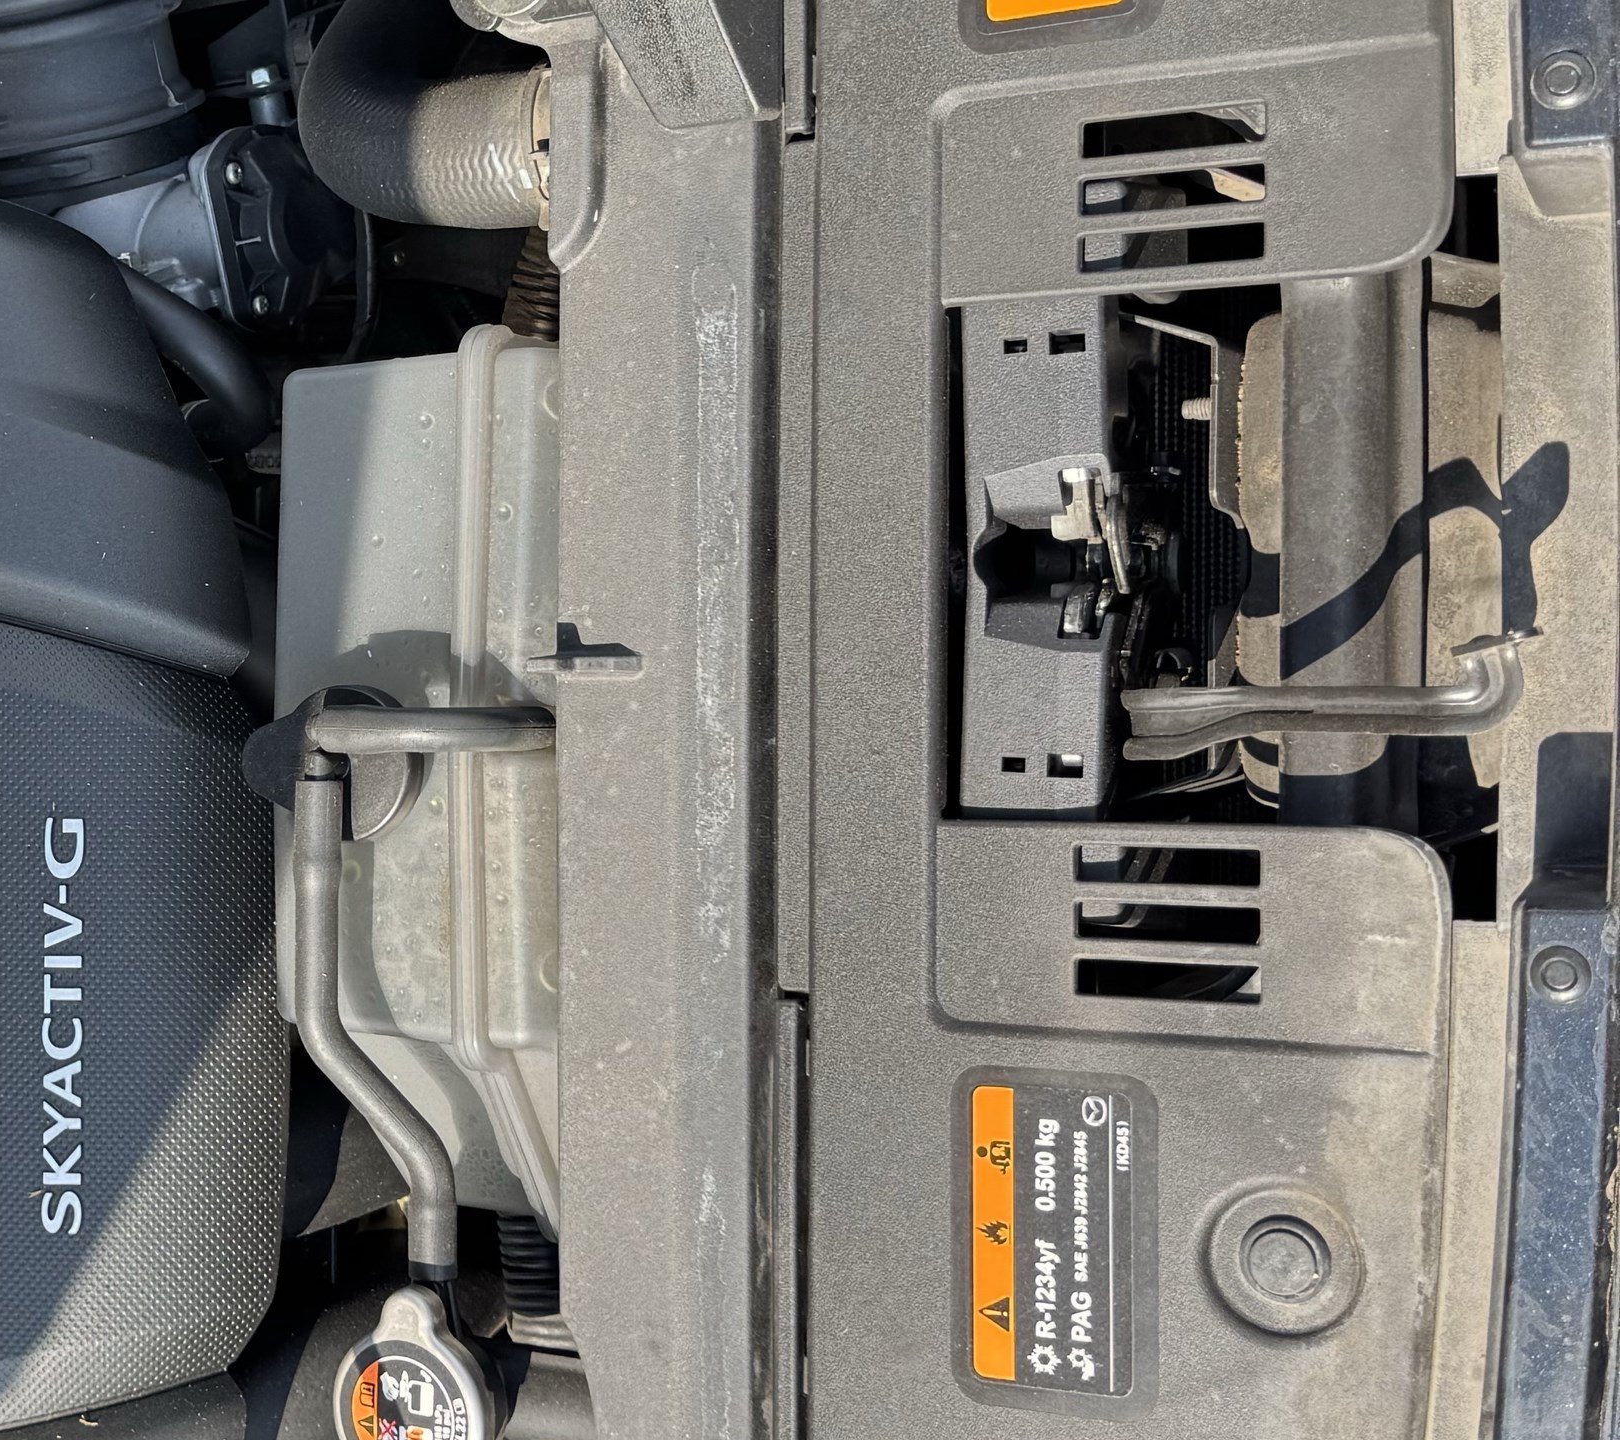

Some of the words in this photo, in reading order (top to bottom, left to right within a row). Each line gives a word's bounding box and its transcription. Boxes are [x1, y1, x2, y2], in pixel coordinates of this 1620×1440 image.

[40, 817, 85, 1236] SKYACTIV-G
[1034, 1118, 1061, 1147] kg
[1115, 1120, 1131, 1172] (KD45)
[1034, 1151, 1057, 1212] 0.500
[1034, 1239, 1062, 1340] R-1234yf
[1073, 1251, 1089, 1282] SAE
[1070, 1290, 1093, 1343] PAG
